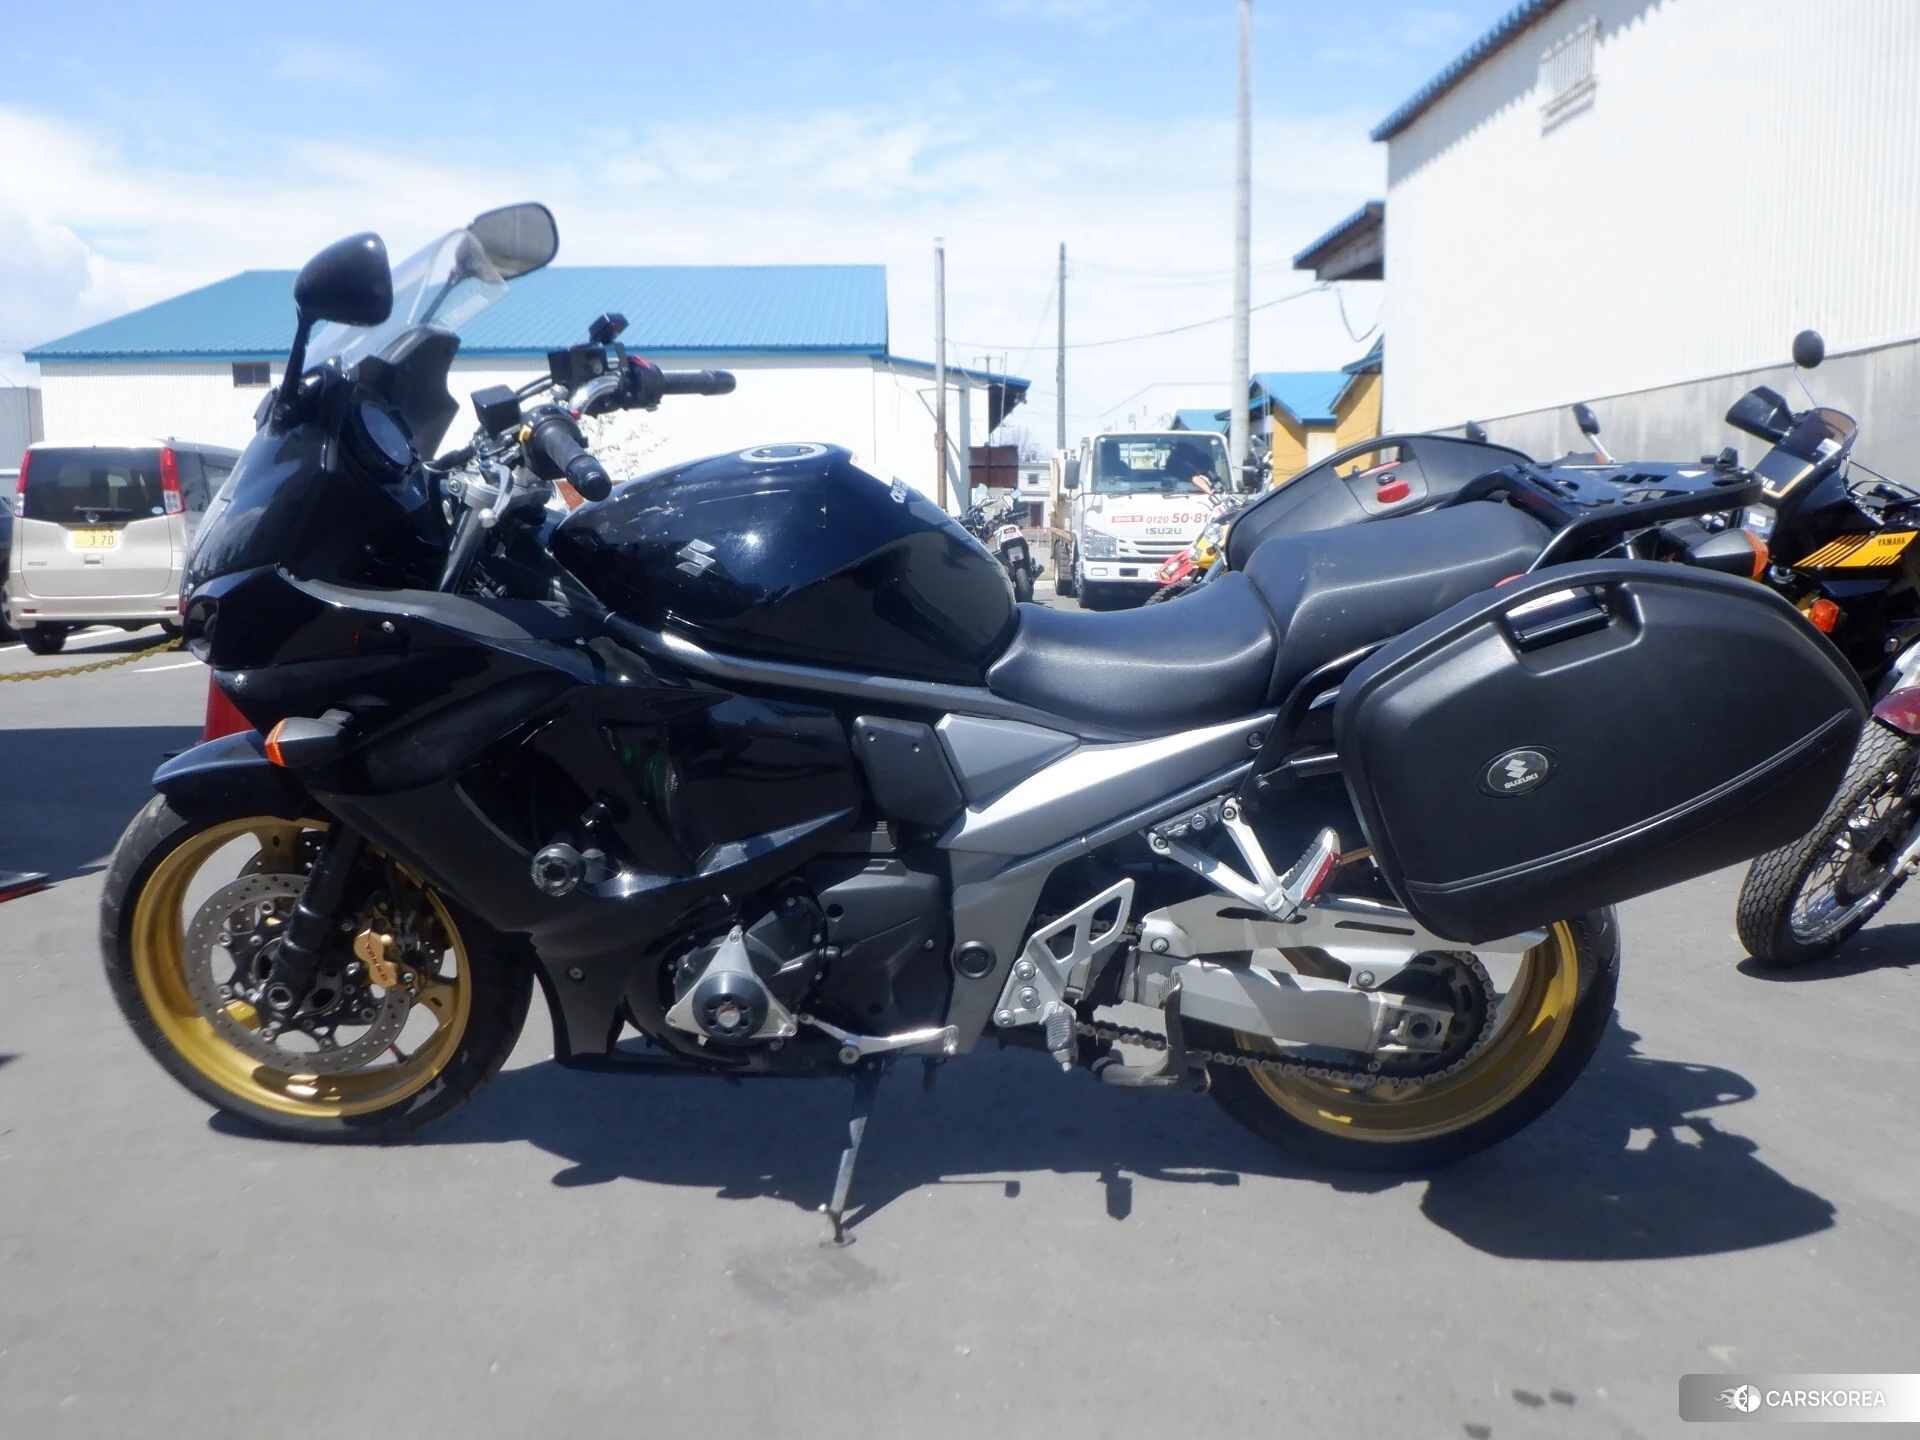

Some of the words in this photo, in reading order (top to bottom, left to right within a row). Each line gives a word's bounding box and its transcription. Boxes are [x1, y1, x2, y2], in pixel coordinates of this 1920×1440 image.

[1146, 516, 1169, 524] 0120
[1171, 512, 1209, 524] 50-81
[1145, 527, 1182, 535] ISUZU
[1877, 537, 1906, 547] YAMAHA
[1504, 772, 1539, 789] SUZUKI
